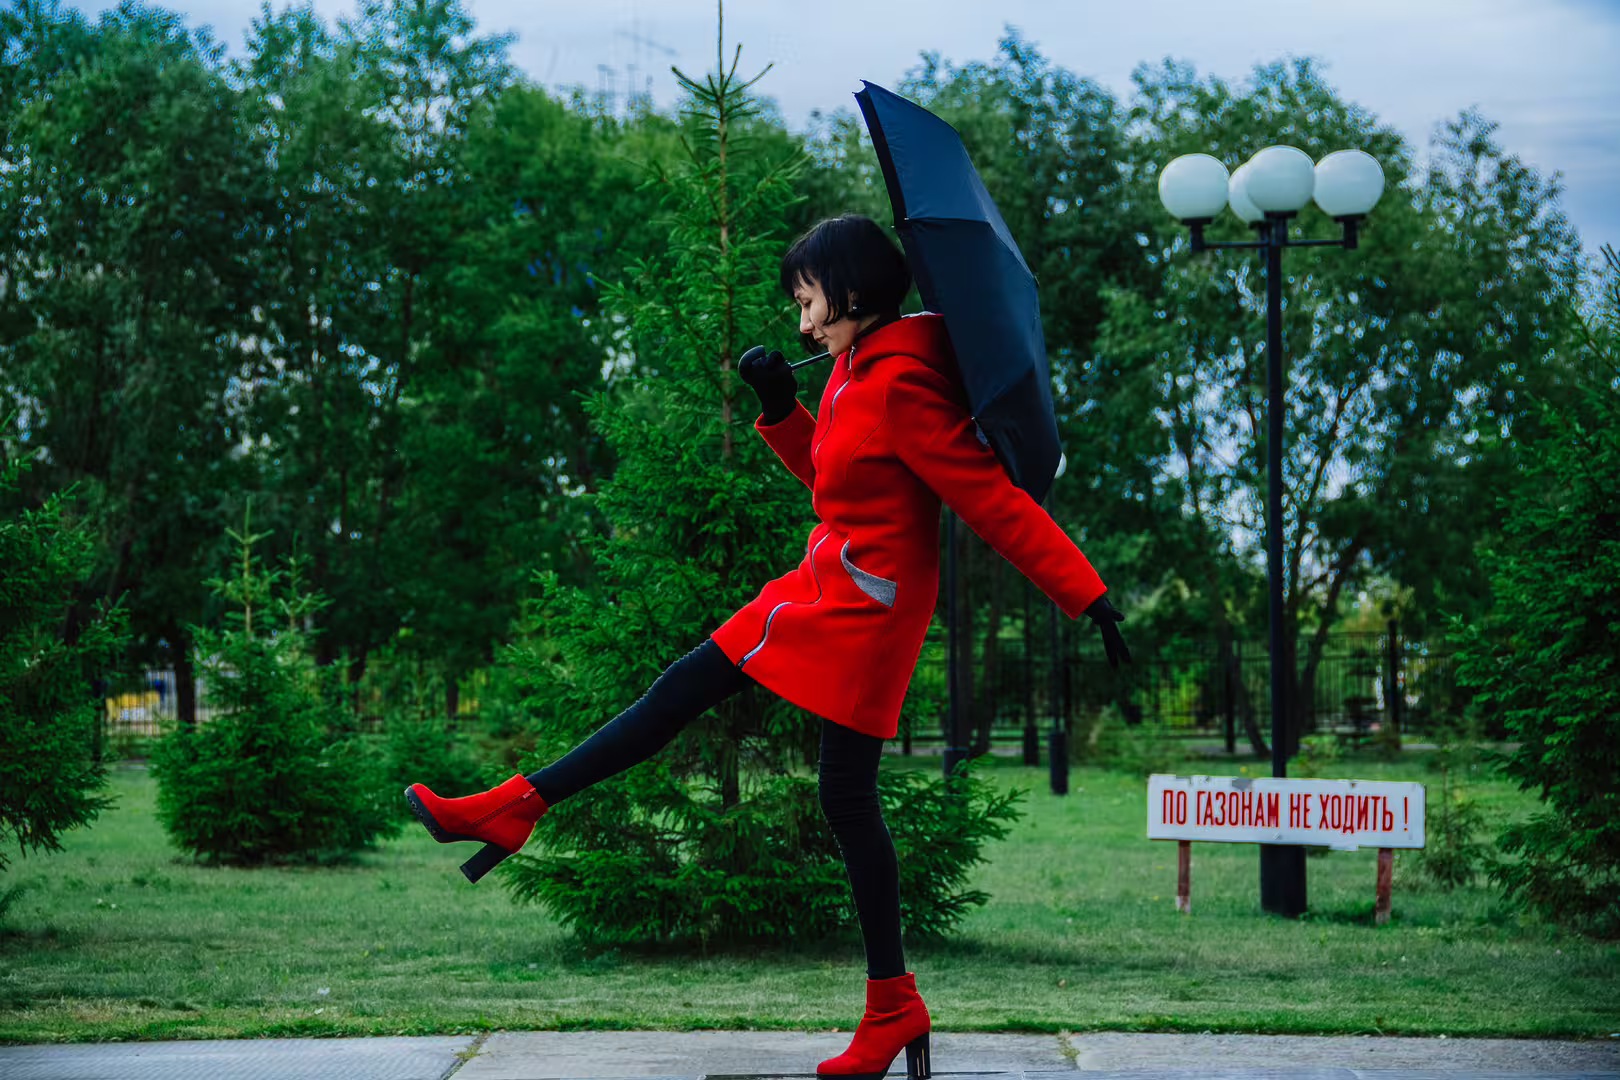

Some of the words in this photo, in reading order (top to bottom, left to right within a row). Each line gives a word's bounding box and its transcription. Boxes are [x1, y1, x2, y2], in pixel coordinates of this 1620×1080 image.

[1162, 789, 1188, 826] ПО
[1196, 790, 1280, 829] ГАЗОНАМ
[1289, 792, 1312, 829] НЕ
[1319, 793, 1394, 834] ХОДИТЬ
